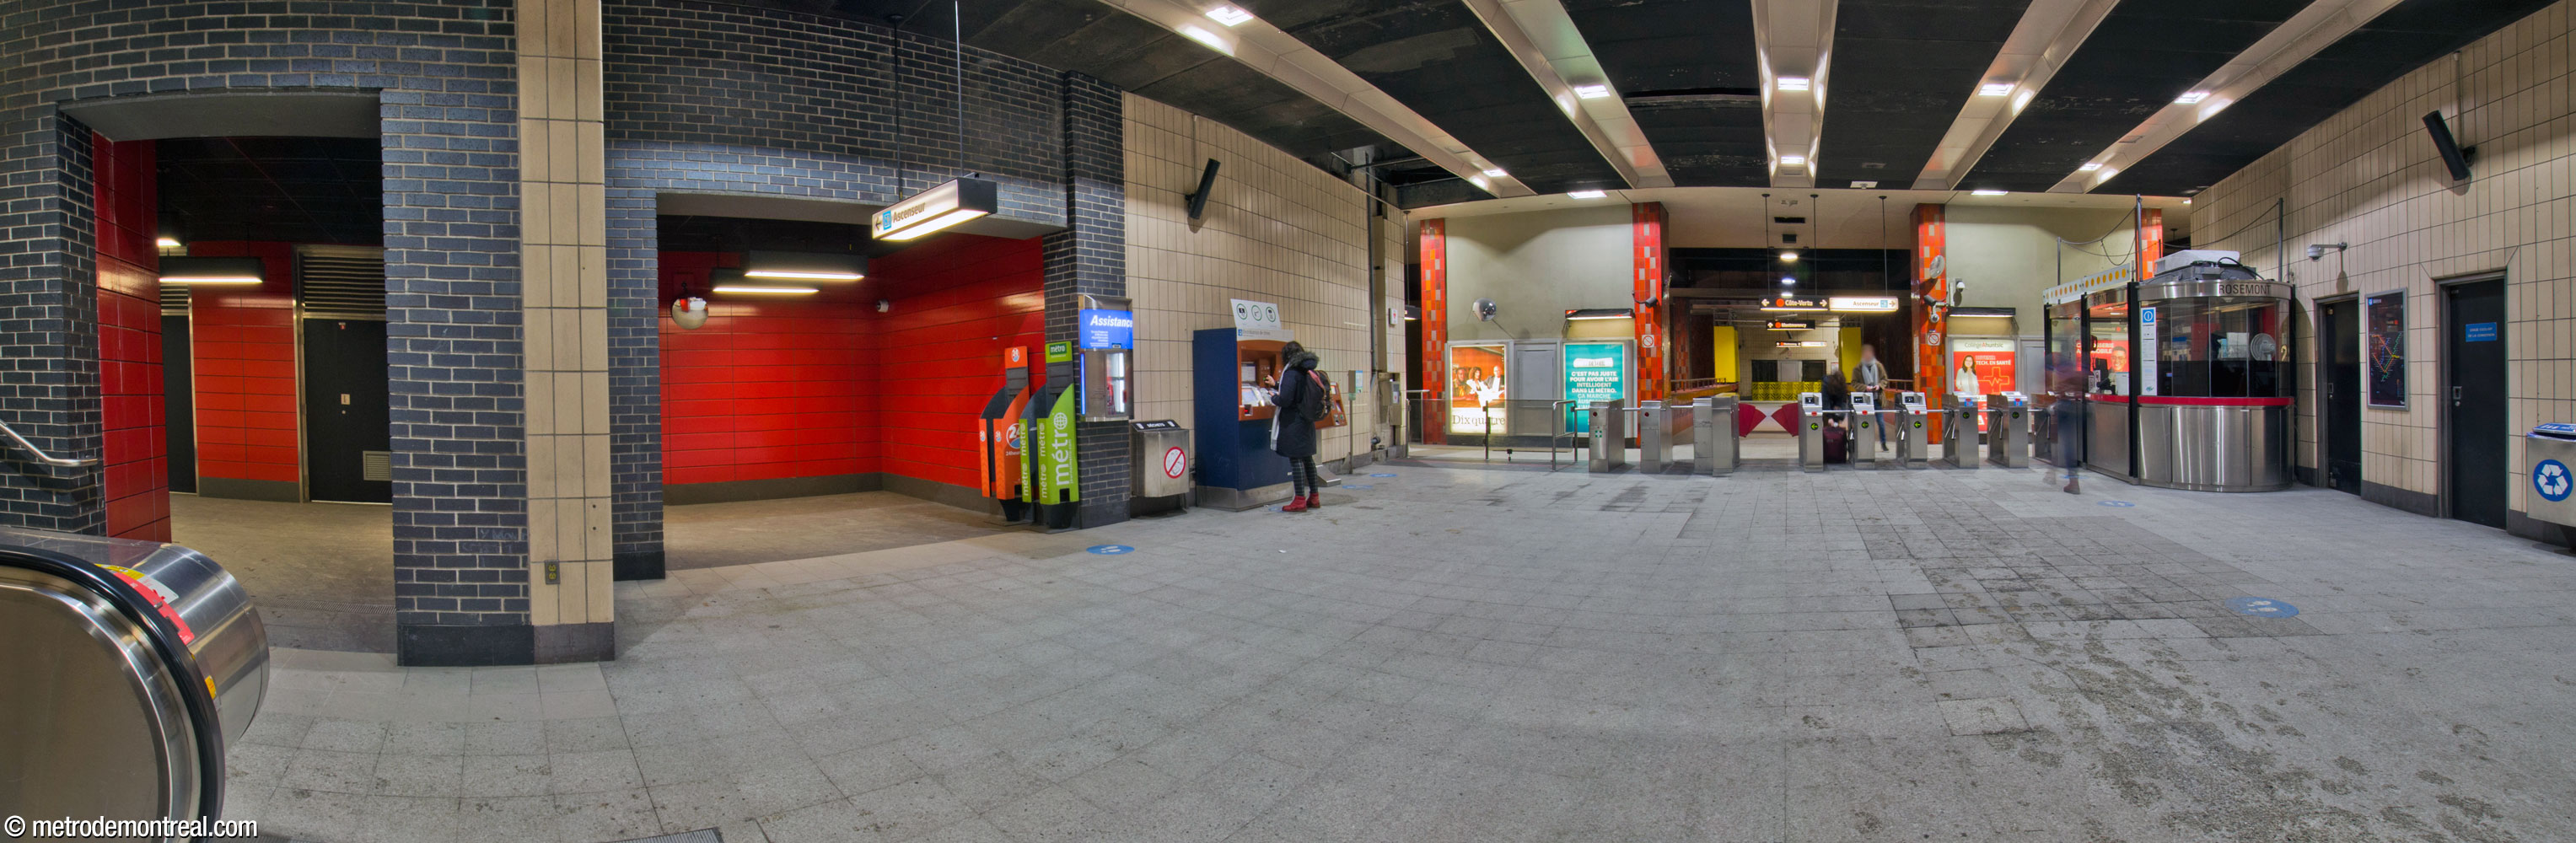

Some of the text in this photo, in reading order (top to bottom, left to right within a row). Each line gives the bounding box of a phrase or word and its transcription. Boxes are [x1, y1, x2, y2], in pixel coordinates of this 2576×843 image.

[892, 201, 926, 223] Ascenseur
[2218, 284, 2272, 294] ROSEMONT
[1784, 298, 1813, 307] Côte-Vertu
[1050, 344, 1067, 354] métro
[1452, 414, 1506, 427] Dix qutre
[1051, 411, 1071, 486] métro
